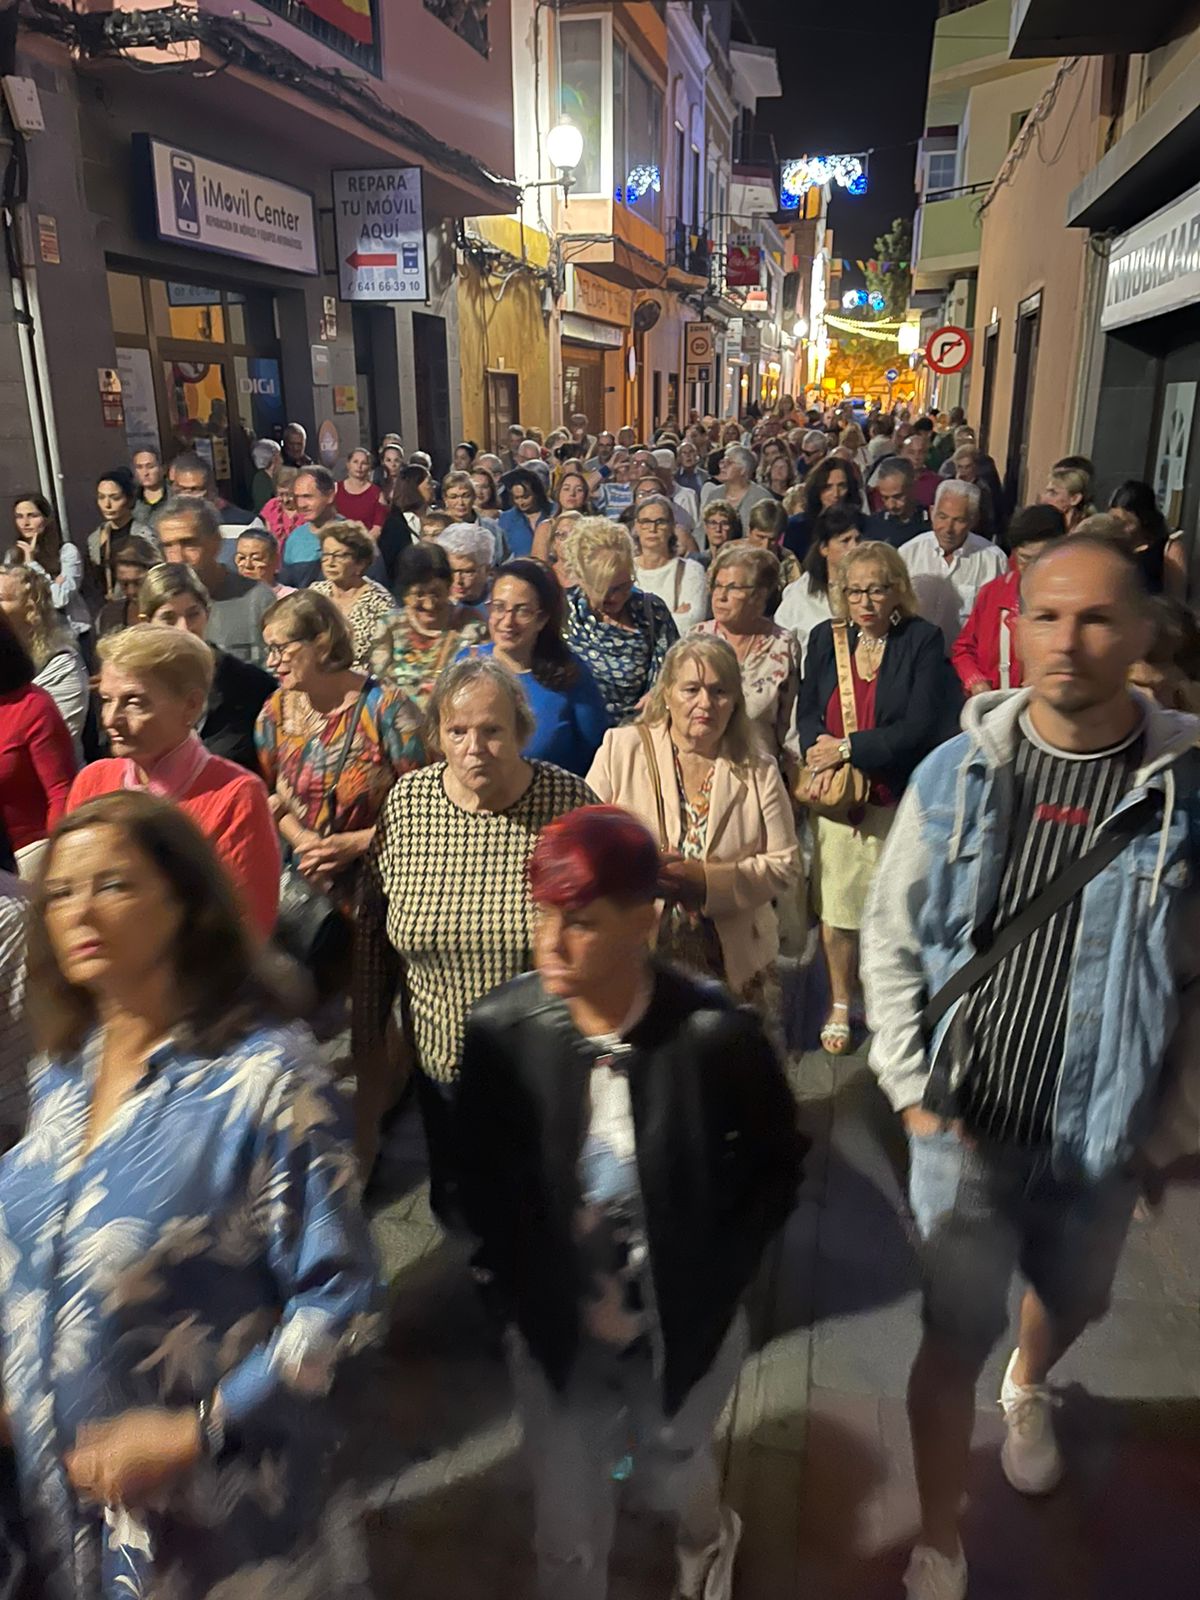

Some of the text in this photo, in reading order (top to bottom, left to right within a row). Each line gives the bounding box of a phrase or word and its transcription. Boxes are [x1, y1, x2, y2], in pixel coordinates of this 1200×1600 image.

[348, 175, 407, 192] REPARA
[202, 176, 300, 232] iMovil Center
[341, 195, 417, 216] TU MÓVIL
[360, 220, 400, 240] AQUÍ
[357, 281, 420, 292] 641 66 39 10
[239, 378, 275, 394] DIGI
